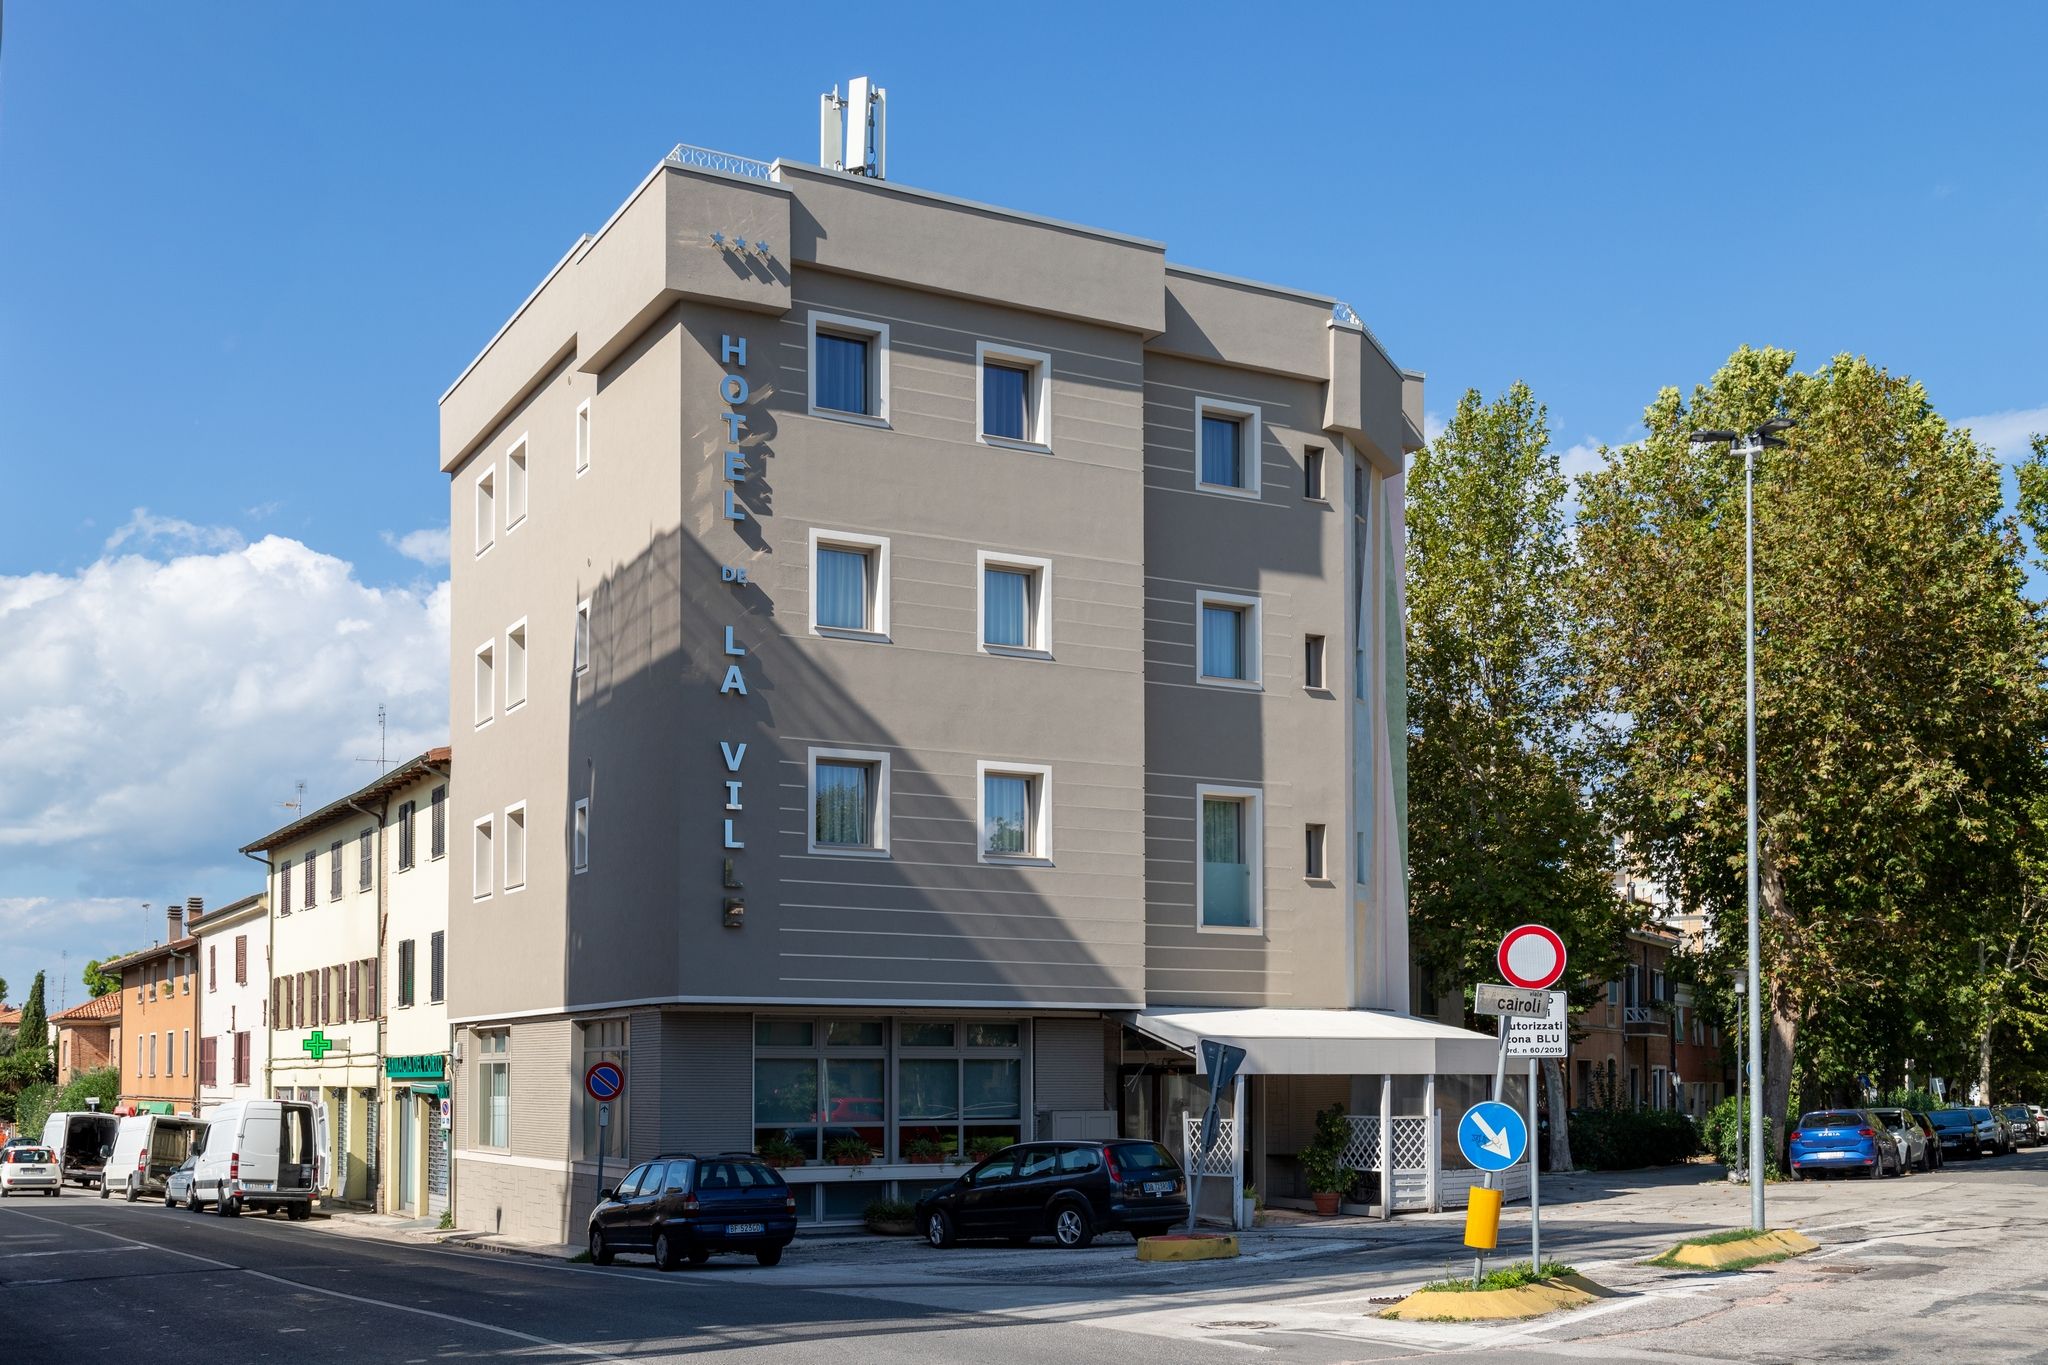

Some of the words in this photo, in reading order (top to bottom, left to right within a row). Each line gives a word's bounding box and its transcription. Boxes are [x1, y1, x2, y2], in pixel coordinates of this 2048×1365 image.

[720, 333, 749, 521] HOTEL
[720, 565, 748, 584] DE
[720, 625, 747, 695] LA
[1497, 998, 1541, 1013] cairoli
[1509, 1021, 1563, 1031] utorizzati
[1536, 1034, 1560, 1043] BLU
